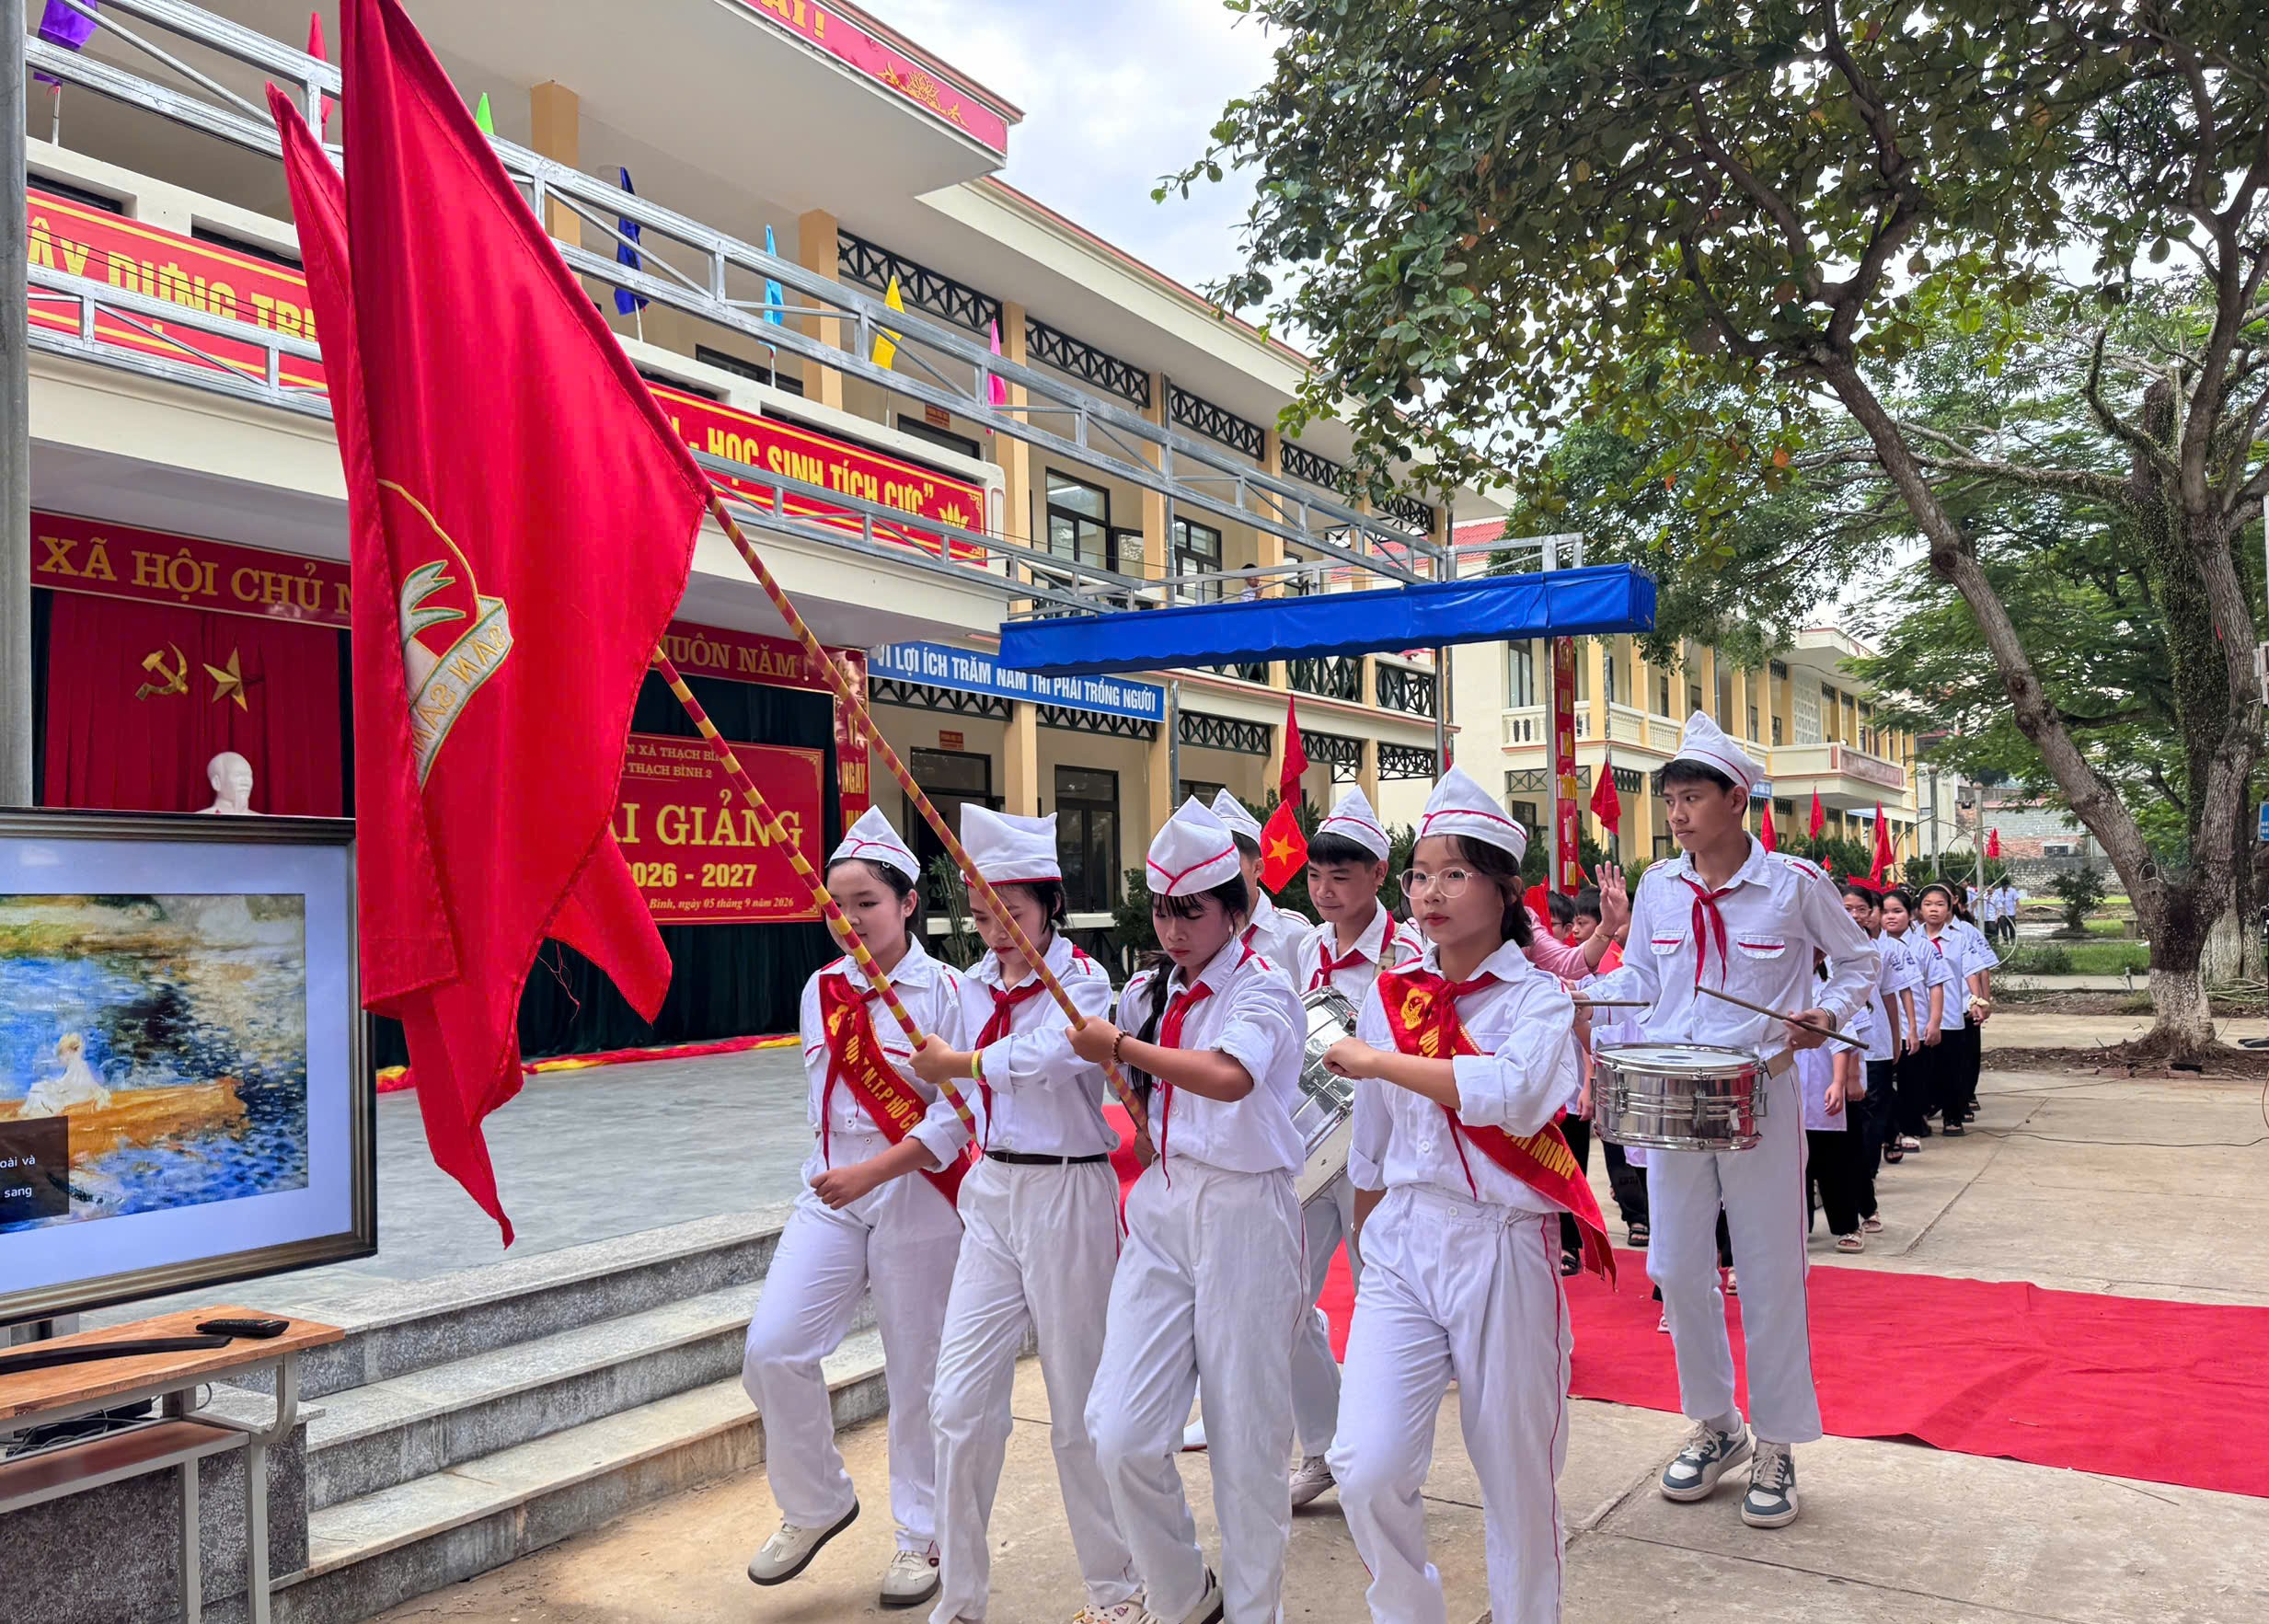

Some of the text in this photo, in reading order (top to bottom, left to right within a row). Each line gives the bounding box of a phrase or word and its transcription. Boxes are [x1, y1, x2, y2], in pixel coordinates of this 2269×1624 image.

[707, 426, 760, 487] HỌC
[766, 444, 824, 488] SINH
[829, 458, 878, 503] TÍCH
[36, 535, 118, 582] XÃ
[131, 547, 219, 602] HỘI
[231, 561, 324, 611] CHỦ
[736, 643, 798, 679] NĂM
[894, 646, 919, 677] LỢI
[923, 647, 948, 678] ÍCH
[951, 655, 992, 685] TRĂM
[1084, 677, 1120, 708] TRỒNG
[1123, 685, 1156, 713] NGƯỜI
[705, 767, 713, 779] 2
[655, 789, 803, 848] GIẢNG
[701, 862, 758, 888] 2027
[744, 898, 752, 907] 9
[774, 896, 794, 908] 2026
[21, 1154, 36, 1166] và
[1528, 1132, 1577, 1181] MINH
[4, 1187, 32, 1199] sang
